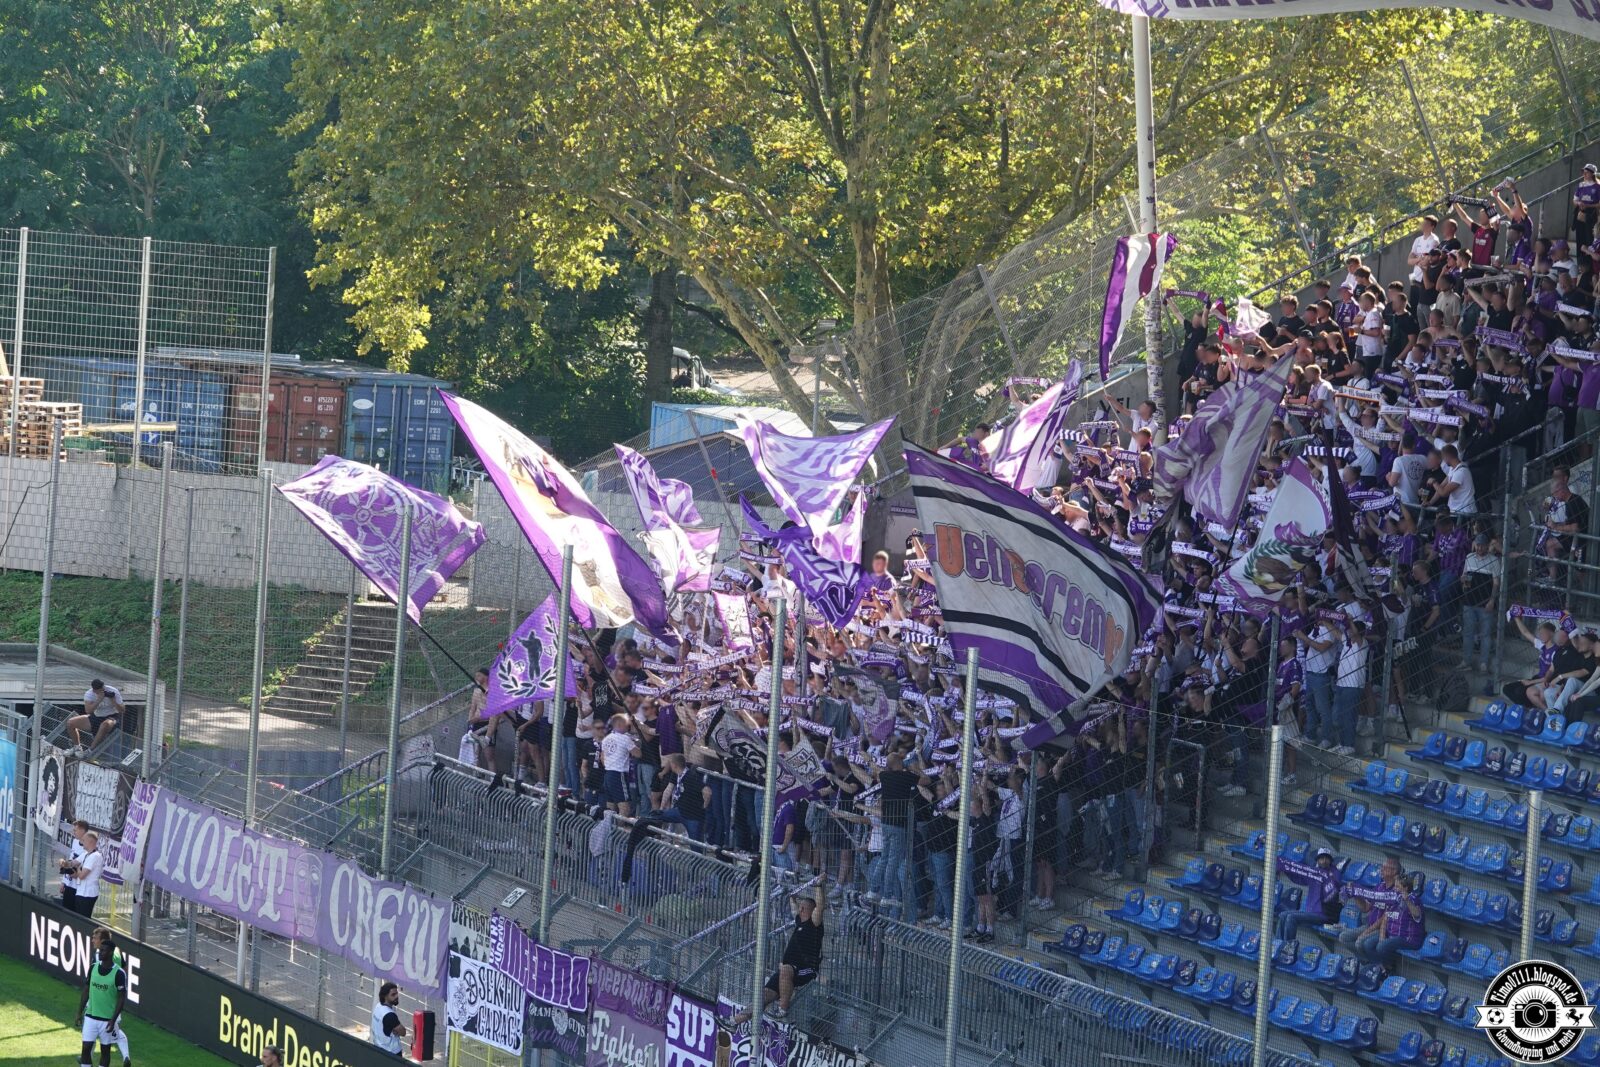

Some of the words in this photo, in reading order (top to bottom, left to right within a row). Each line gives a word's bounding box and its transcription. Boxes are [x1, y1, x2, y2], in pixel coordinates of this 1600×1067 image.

[153, 798, 288, 922] VIOLET
[329, 863, 445, 988] CREW
[219, 994, 278, 1060] Brand
[666, 994, 715, 1053] SUP
